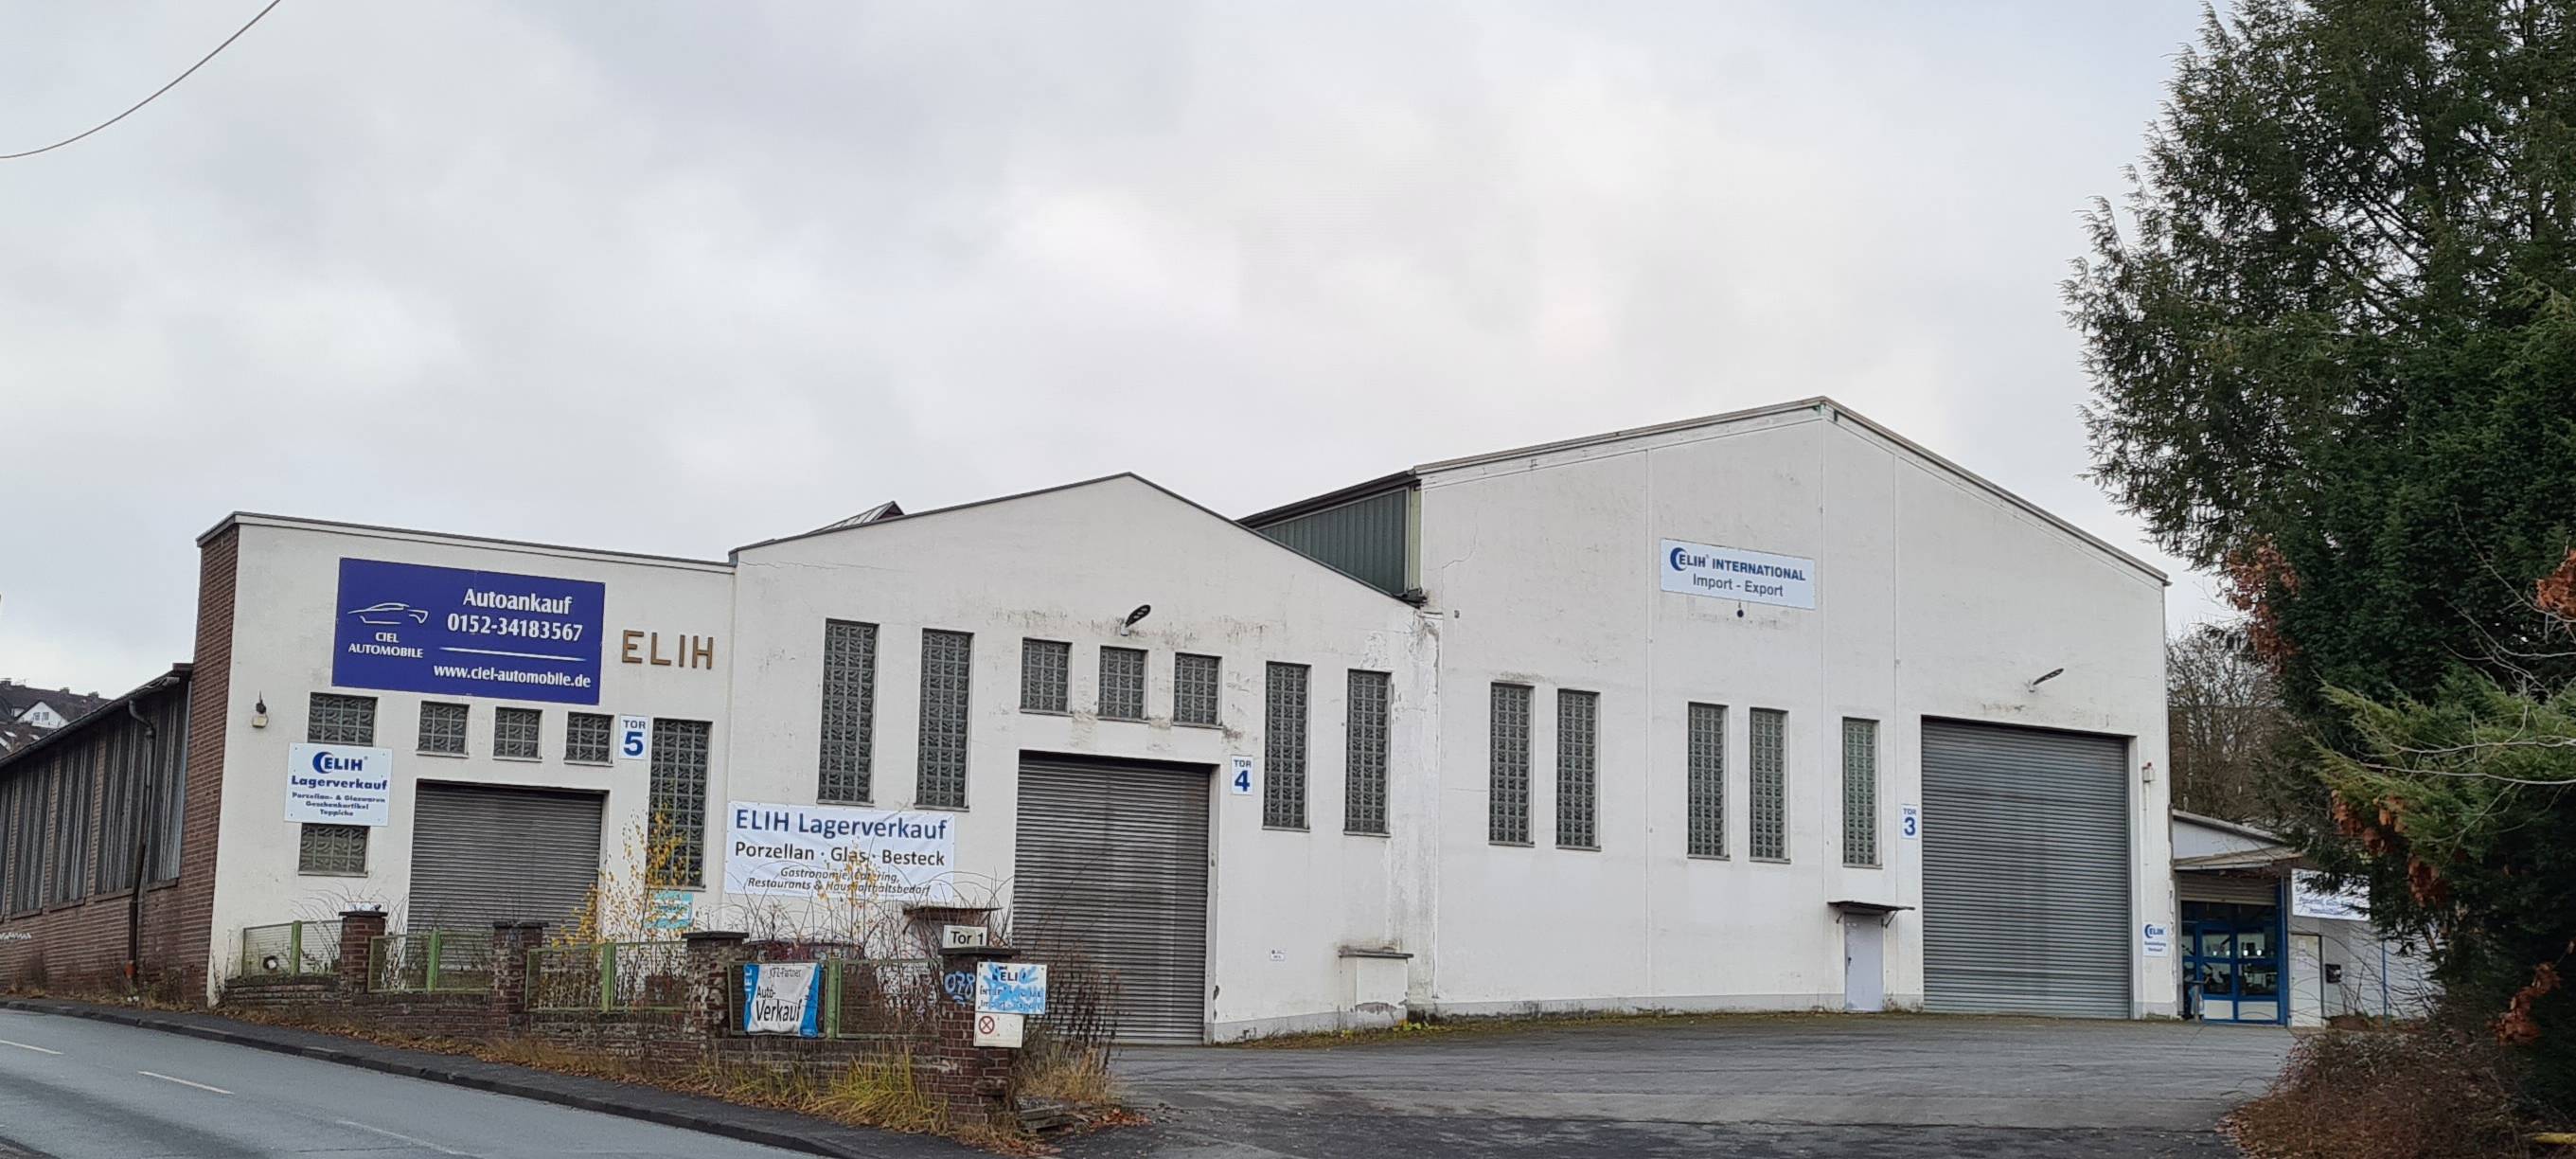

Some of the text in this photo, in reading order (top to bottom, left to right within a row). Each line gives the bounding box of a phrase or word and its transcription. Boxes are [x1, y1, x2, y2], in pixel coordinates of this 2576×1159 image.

[1679, 554, 1806, 581] ELIH INTERNATIONAL
[1693, 574, 1732, 590] Import
[1745, 580, 1784, 597] Export
[463, 588, 573, 615] Autoankauf
[375, 632, 400, 643] CIEL
[447, 614, 583, 642] 0152-34183567
[348, 644, 424, 658] AUTOMOBILE
[622, 630, 714, 669] ELIH
[434, 665, 592, 688] www.ciel-automobile.de
[623, 720, 646, 729] TOR
[623, 731, 644, 756] 5
[325, 758, 364, 772] ELIH
[1234, 759, 1252, 768] TOR
[292, 776, 388, 790] Lagerverkauf
[1235, 770, 1251, 792] 4
[306, 801, 369, 810] Geschenkartikel
[736, 809, 948, 839] ELIH Lagerverkauf
[1904, 816, 1916, 836] 3
[735, 841, 815, 861] Porzellan
[830, 846, 867, 863] Glas
[881, 848, 946, 866] Besteck
[748, 877, 811, 890] Restaurants
[854, 868, 899, 883] Catring,
[950, 931, 984, 945] Tor 1
[1000, 972, 1027, 982] ELI
[755, 998, 803, 1022] Verkauf
